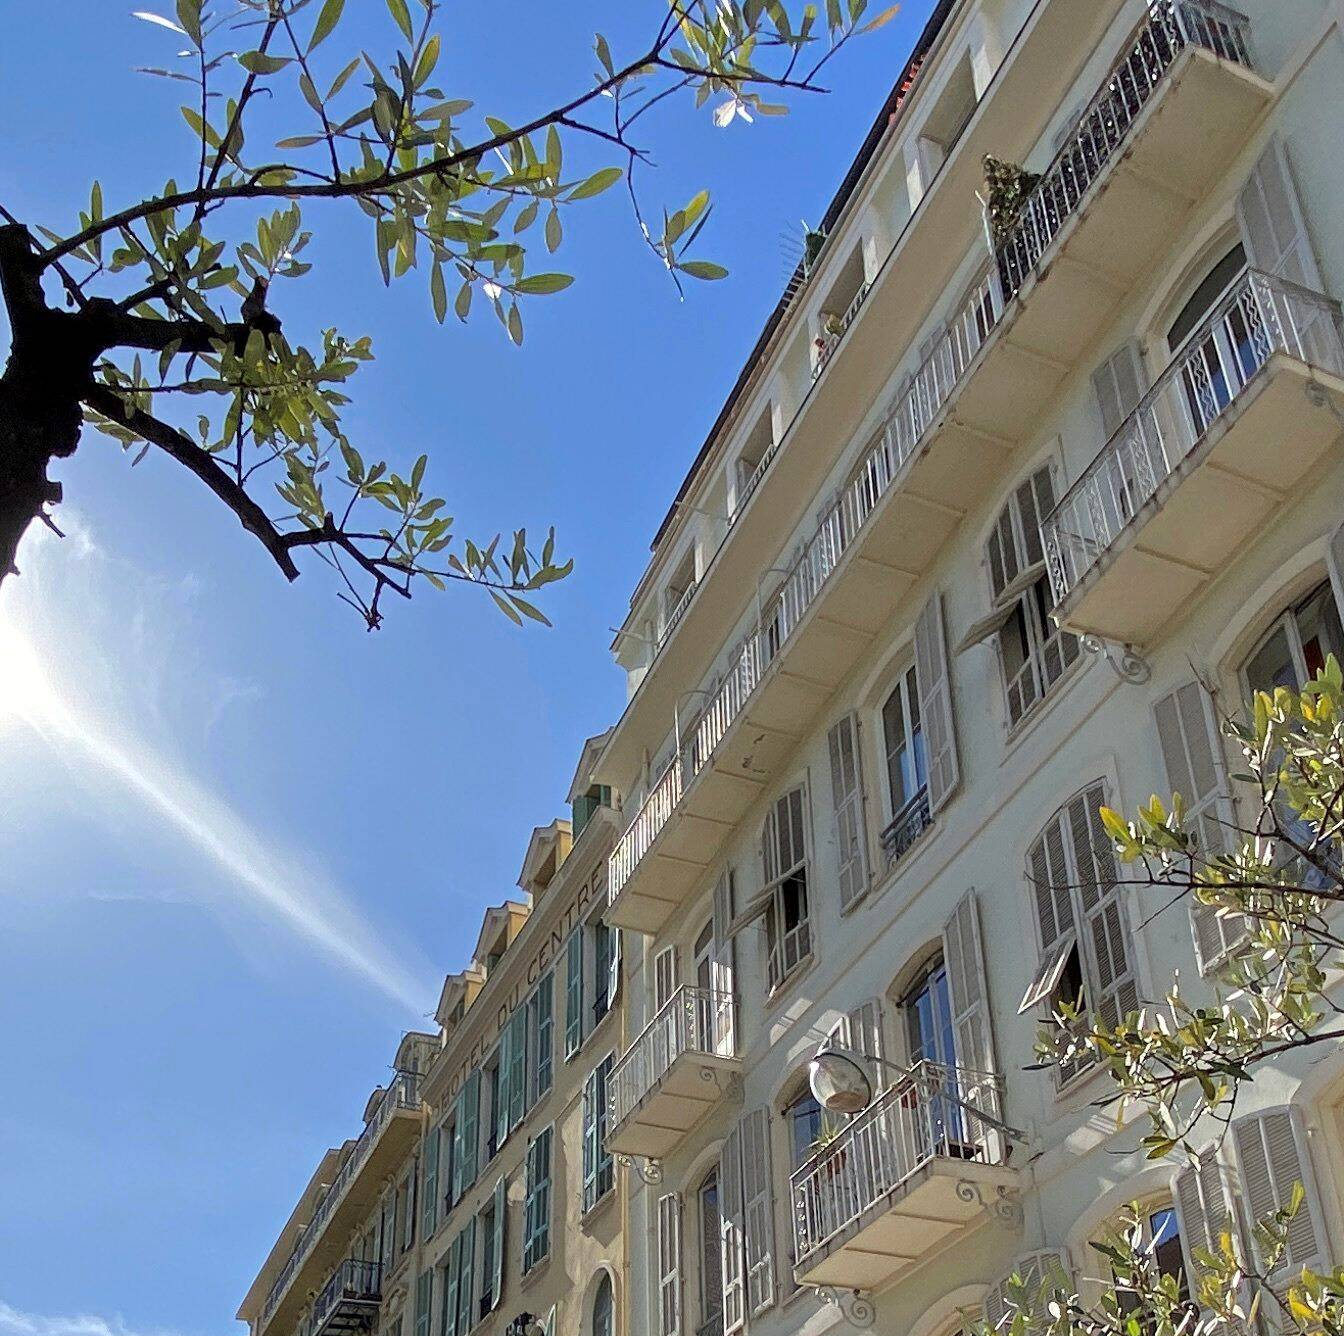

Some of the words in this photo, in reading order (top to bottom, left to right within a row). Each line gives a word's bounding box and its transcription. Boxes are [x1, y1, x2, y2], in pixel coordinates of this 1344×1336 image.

[441, 1034, 490, 1114] HOTEL
[498, 983, 519, 1030] DU
[527, 861, 603, 985] CENTRE
